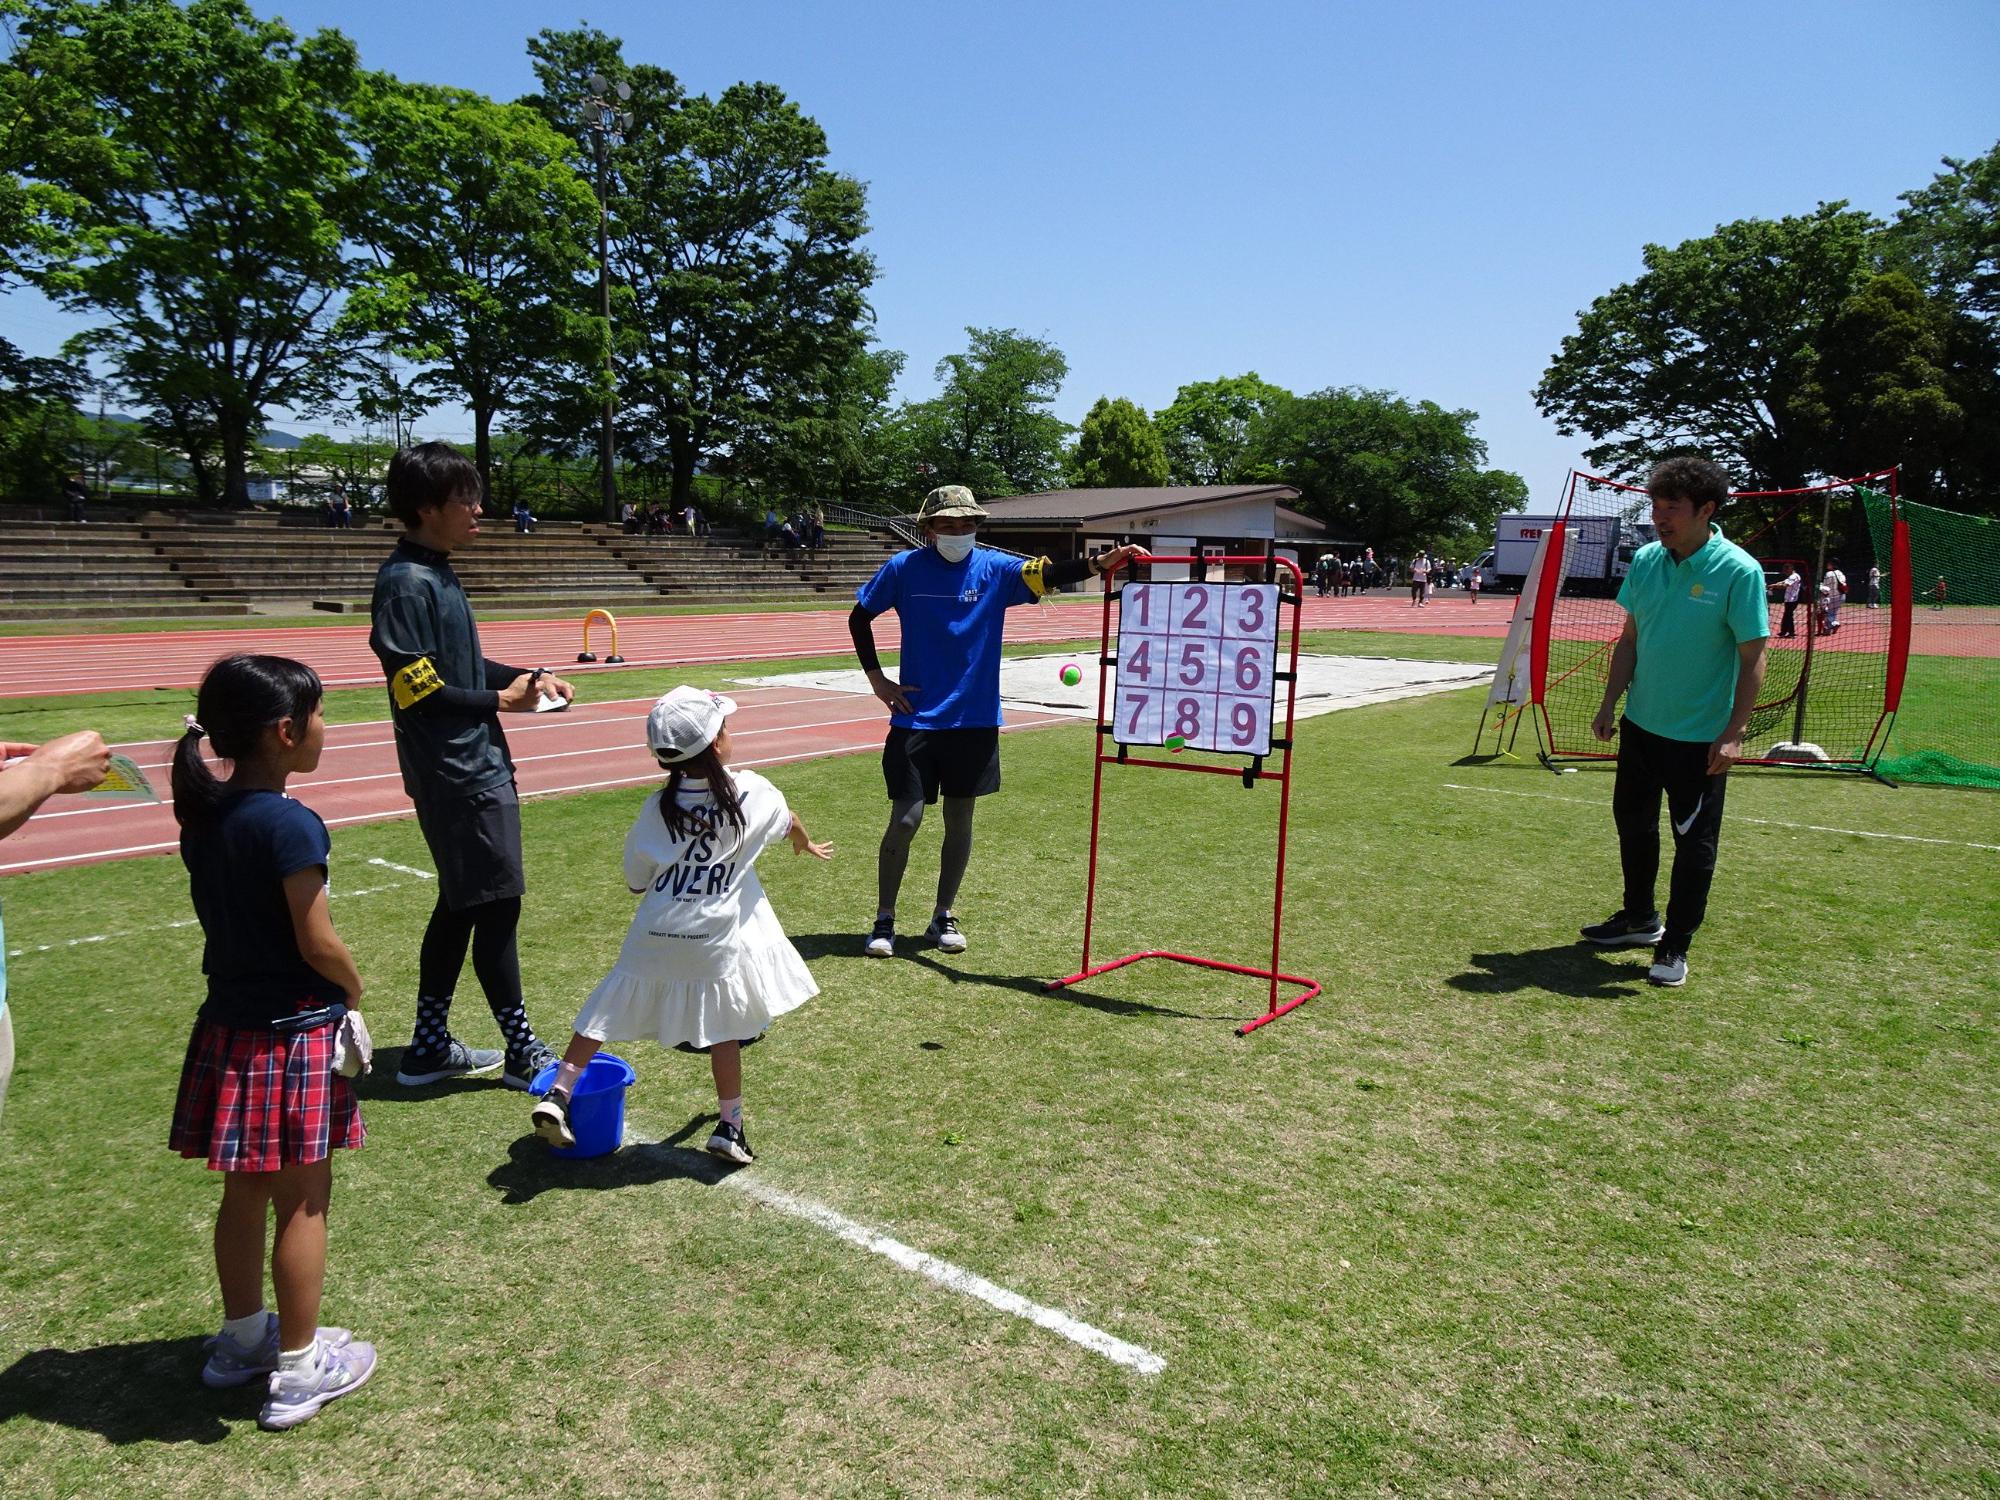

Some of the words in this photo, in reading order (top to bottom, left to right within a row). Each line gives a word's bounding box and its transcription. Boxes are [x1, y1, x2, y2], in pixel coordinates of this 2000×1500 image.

[1133, 585, 1150, 627] 1
[1182, 586, 1209, 630] 2
[1238, 588, 1264, 633] 3
[1126, 640, 1152, 682] 4
[1179, 643, 1205, 686] 5
[1235, 647, 1261, 691] 6
[1126, 693, 1149, 735] 7
[1175, 697, 1201, 741] 8
[1231, 702, 1257, 747] 9
[684, 832, 712, 863] IS
[655, 862, 735, 897] OVER!
